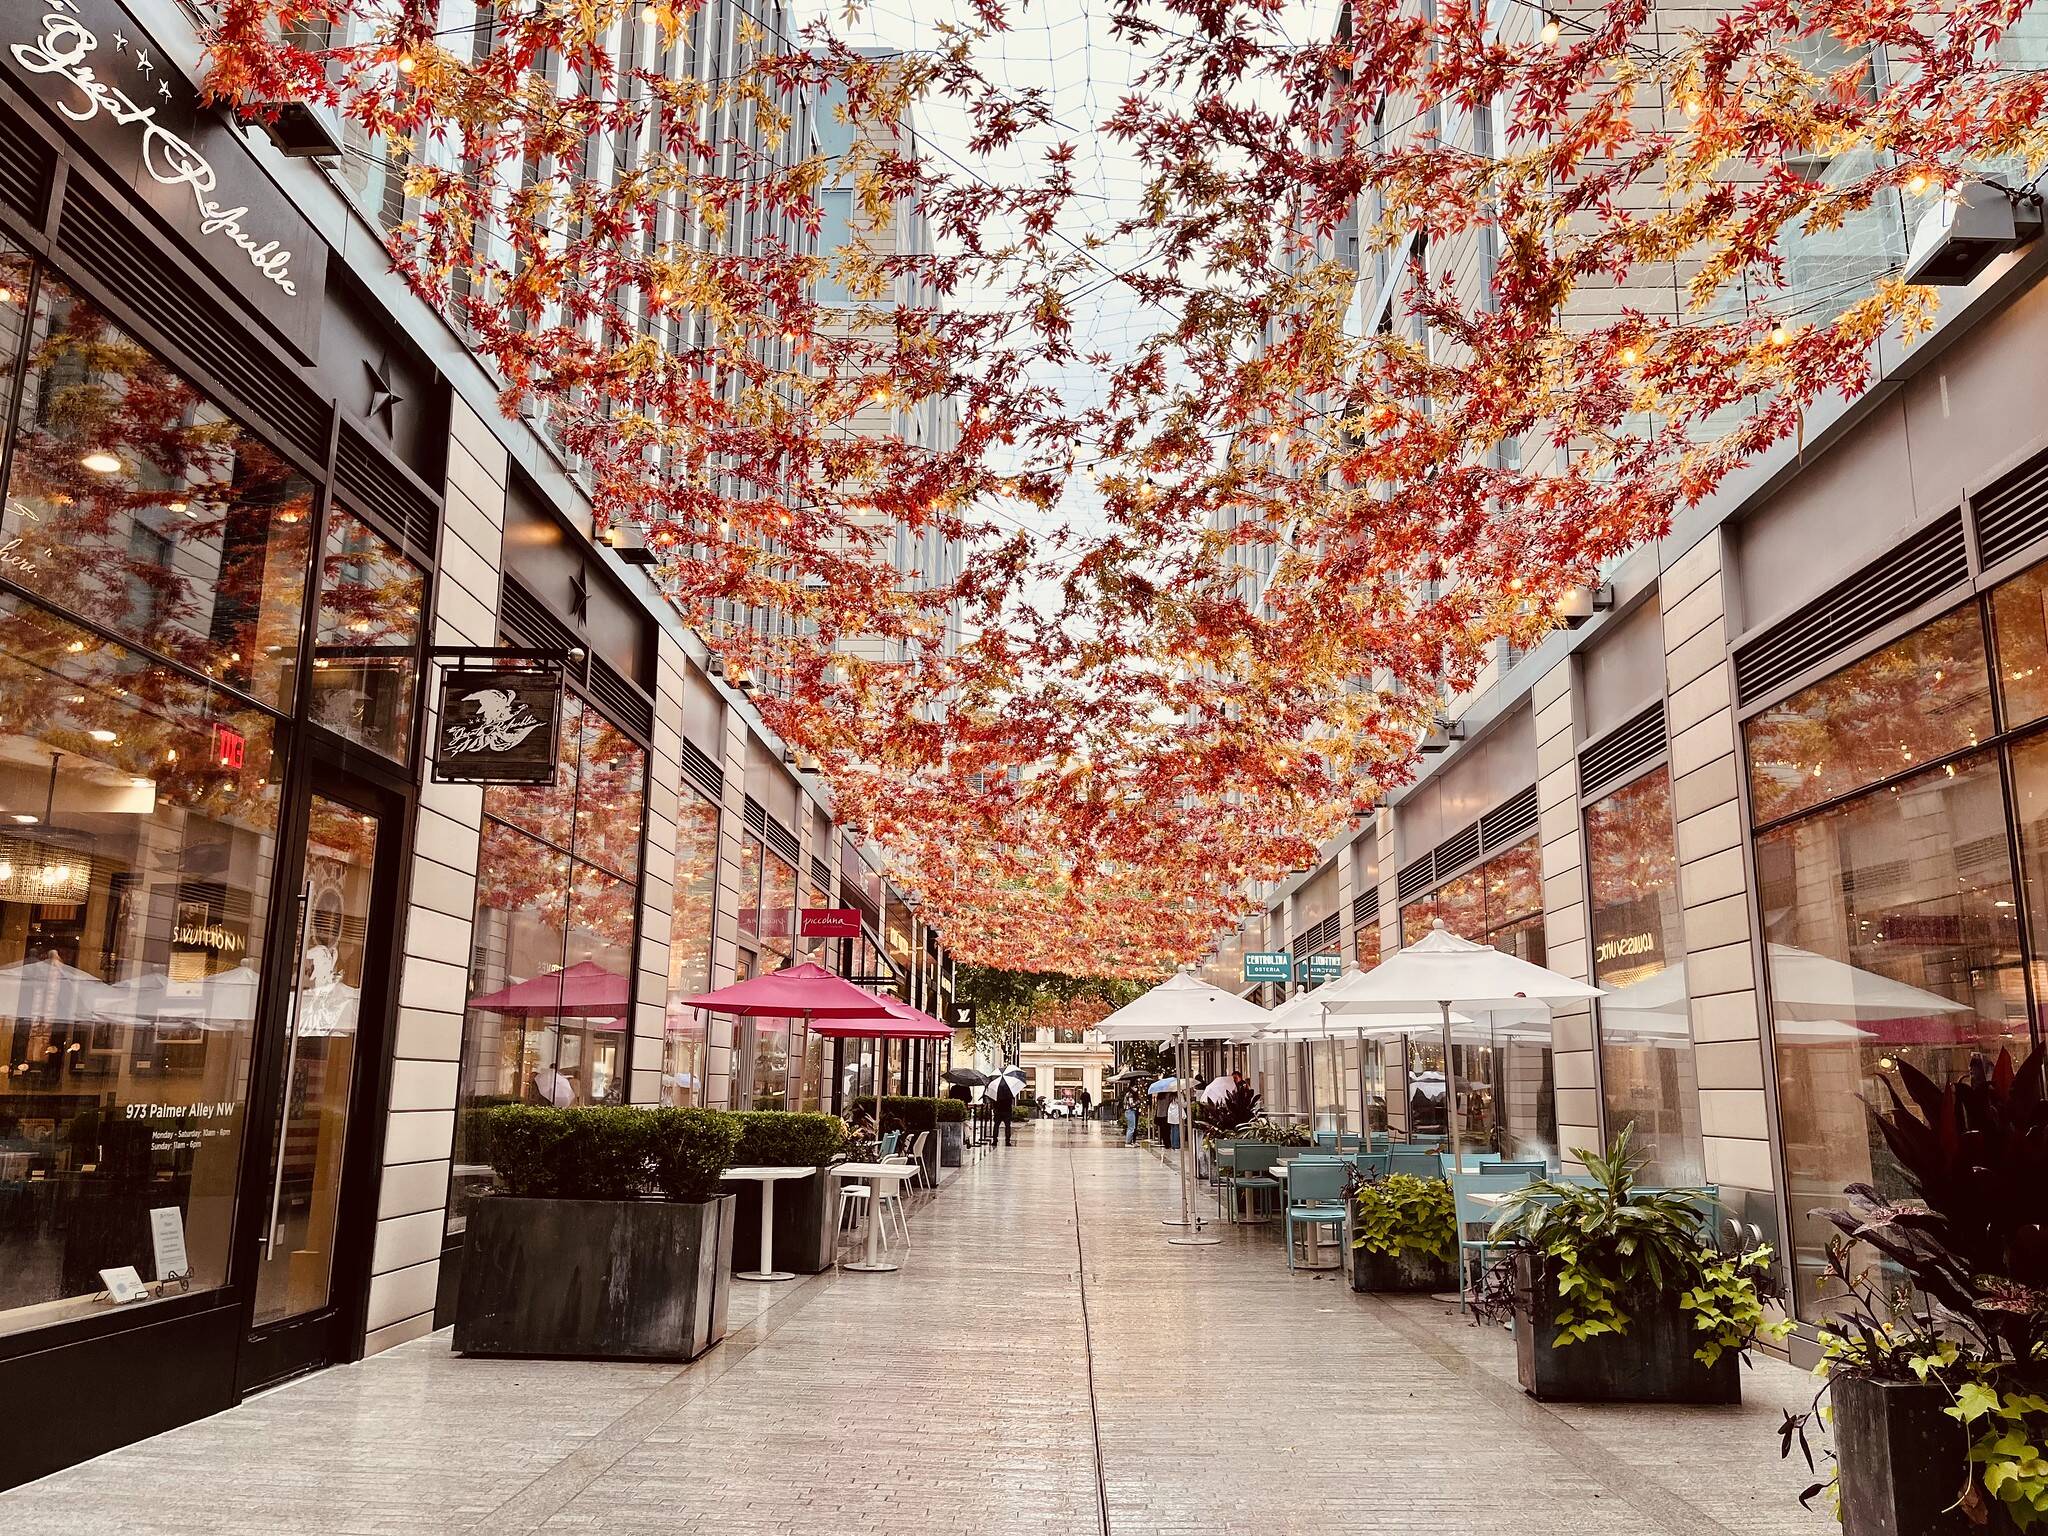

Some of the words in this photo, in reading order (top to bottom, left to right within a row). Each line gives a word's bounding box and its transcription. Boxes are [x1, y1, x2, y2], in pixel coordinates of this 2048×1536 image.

[10, 14, 155, 125] Great
[143, 124, 297, 297] Republic
[803, 913, 858, 933] piccolina
[1246, 955, 1288, 965] CENTROLINA
[126, 1104, 147, 1119] 973
[149, 1103, 187, 1118] Palmer
[188, 1102, 214, 1119] Alley
[216, 1102, 235, 1116] NW
[152, 1131, 174, 1140] Monday
[151, 1142, 172, 1151] Sunday:
[190, 1141, 201, 1149] 6pm
